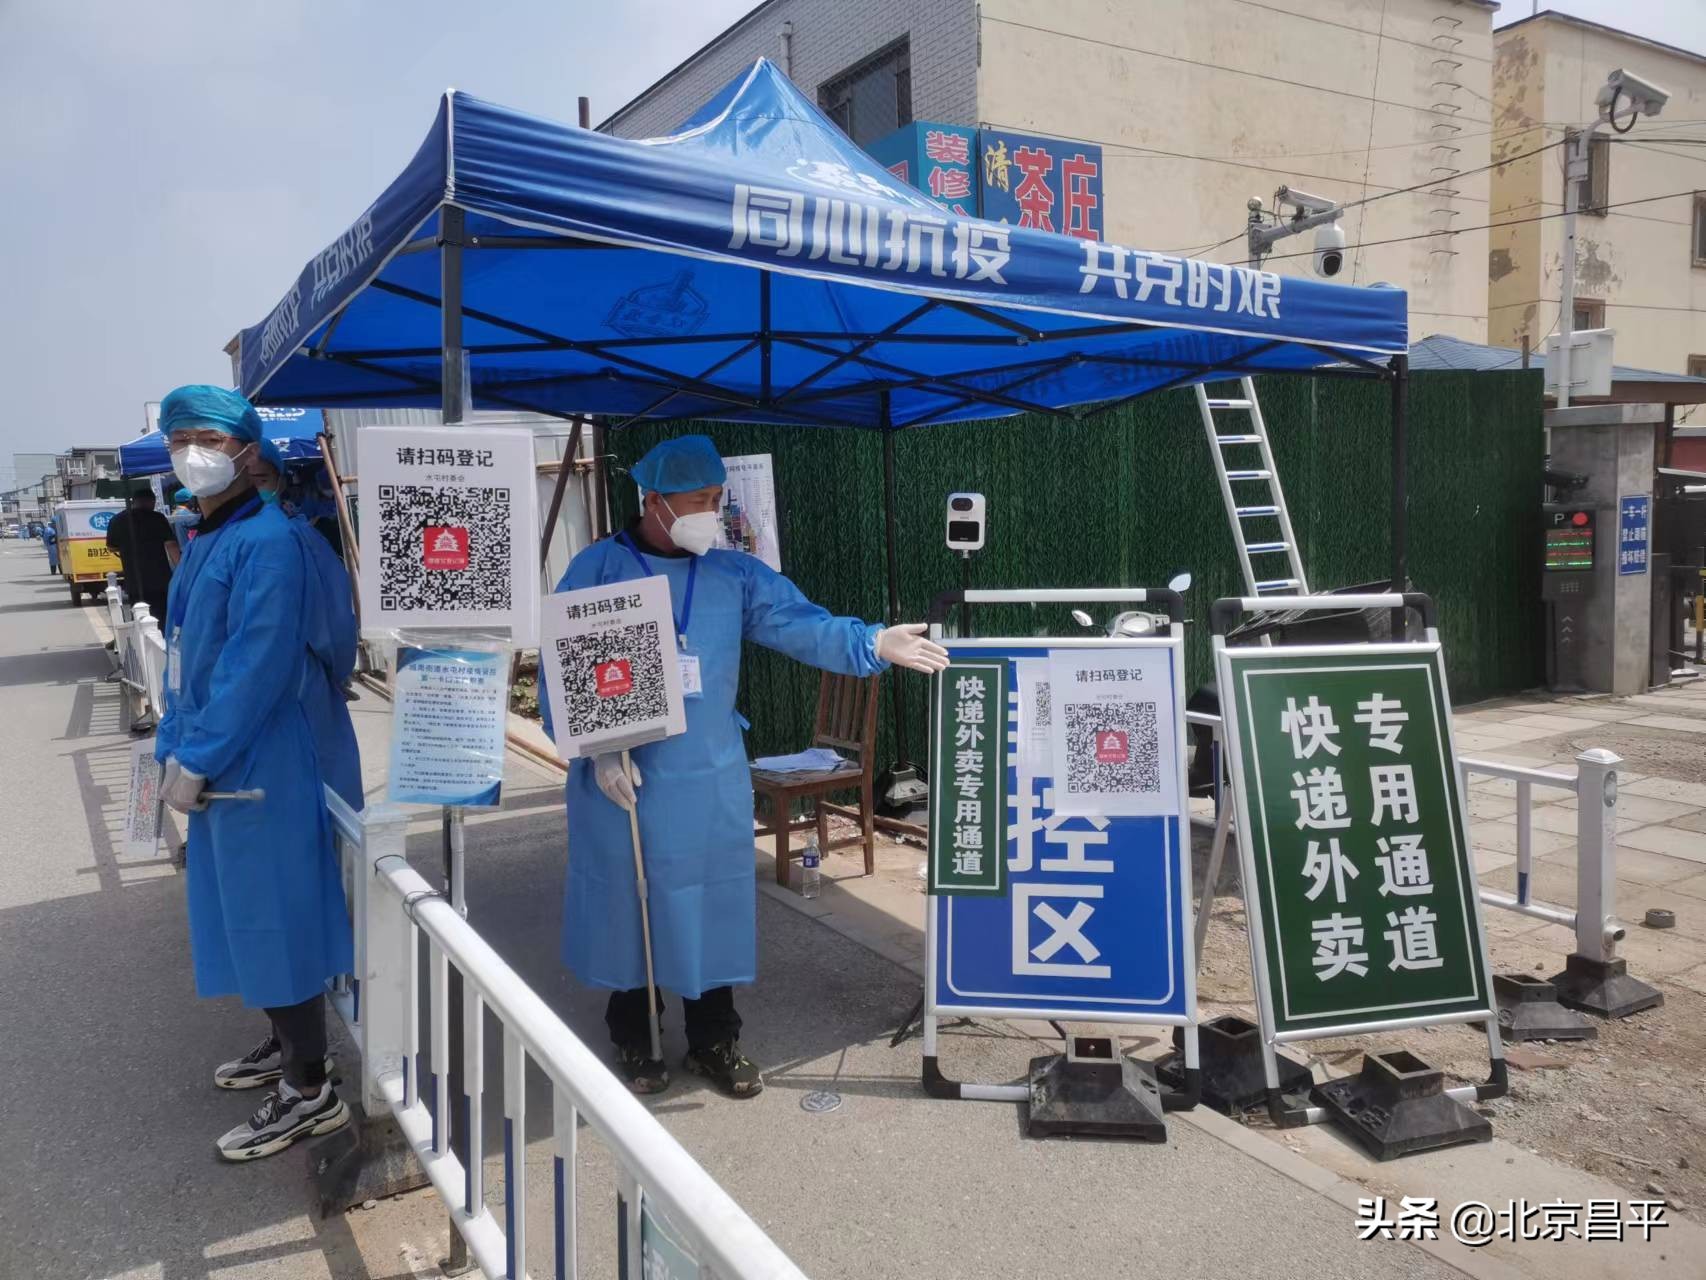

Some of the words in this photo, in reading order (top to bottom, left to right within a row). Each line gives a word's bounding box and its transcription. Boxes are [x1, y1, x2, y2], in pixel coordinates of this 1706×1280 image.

[926, 131, 972, 216] 装修
[1013, 145, 1100, 240] 茶庄
[728, 184, 1010, 286] 同心抗疫
[1079, 240, 1281, 318] 共克时艰
[396, 447, 494, 467] 请扫码登记
[1554, 513, 1565, 525] P
[566, 594, 643, 620] 请扫码登记
[1075, 668, 1143, 683] 请扫码登记
[951, 675, 986, 876] 快递外卖专用通道
[1281, 696, 1369, 982] 快递外卖
[1354, 693, 1444, 972] 专用通道
